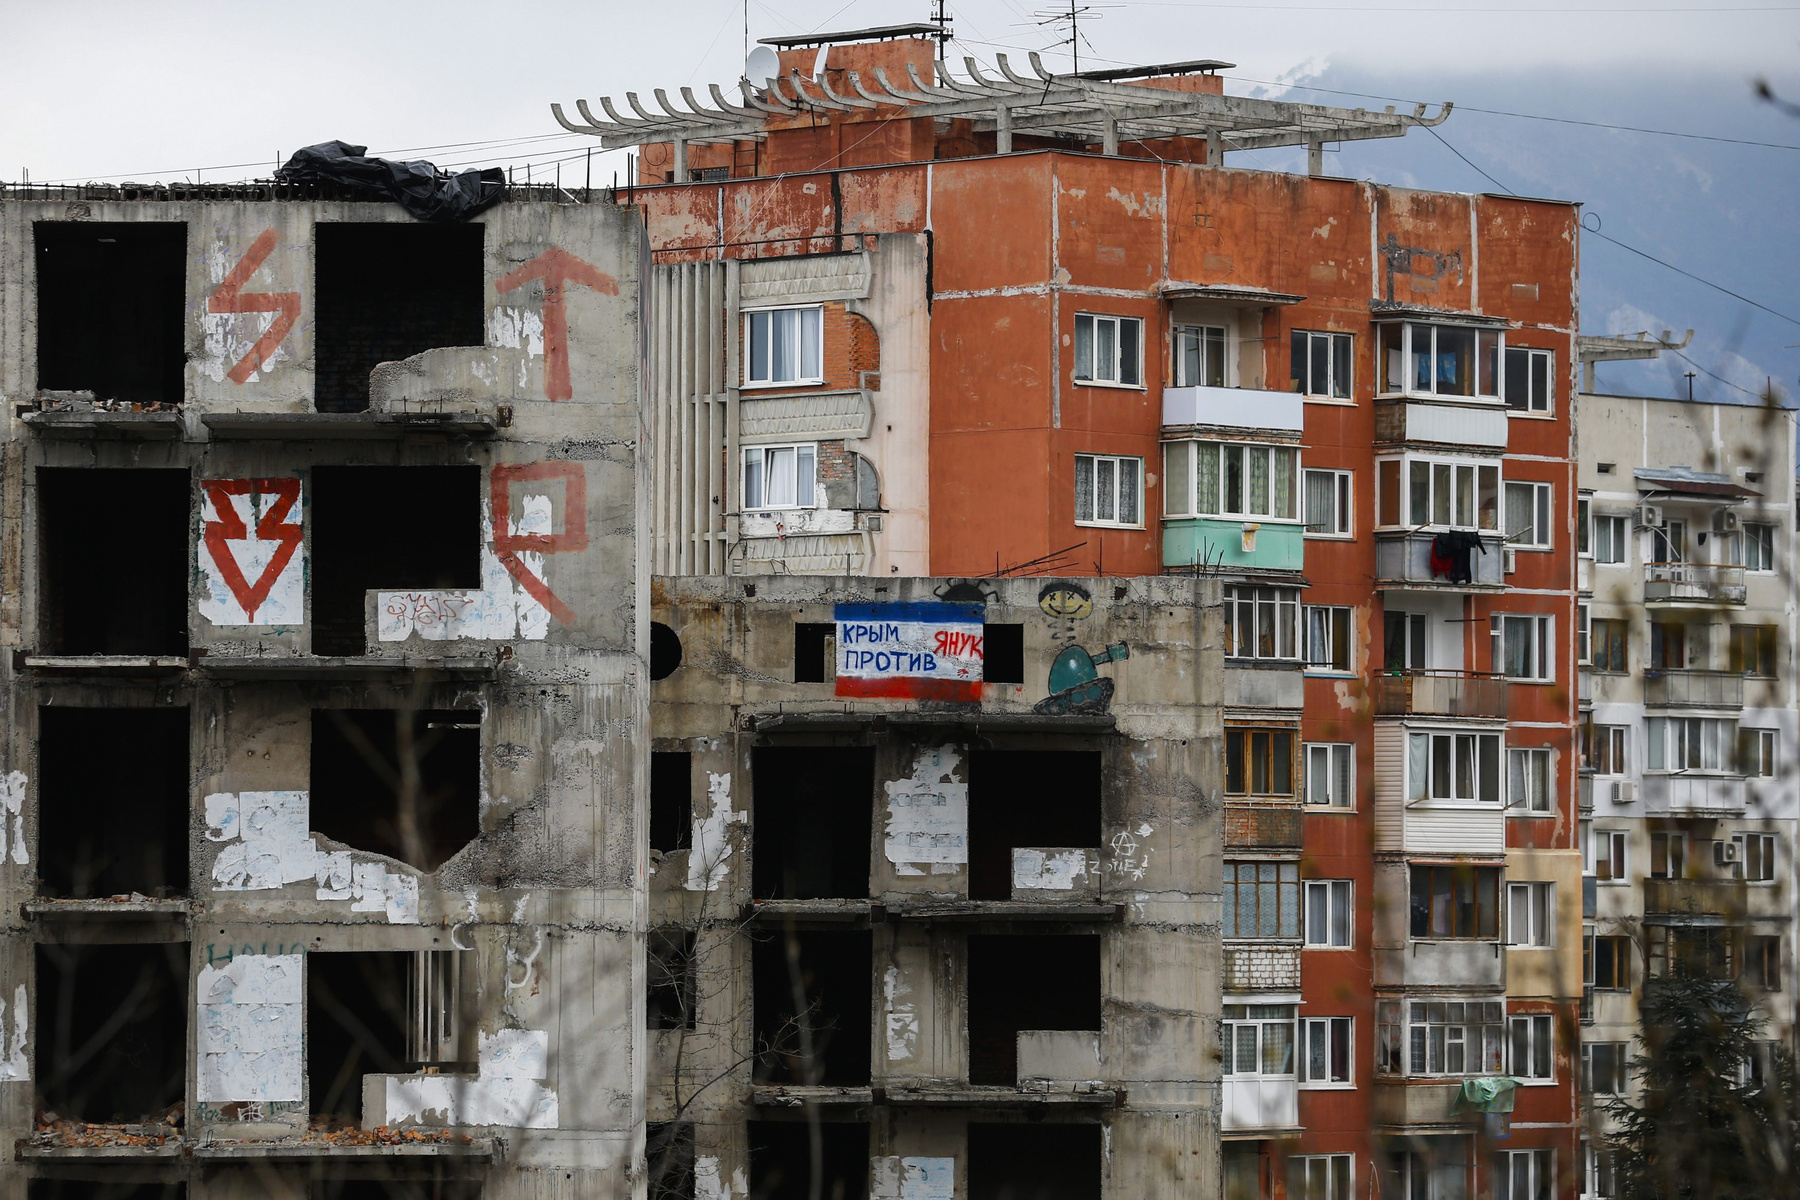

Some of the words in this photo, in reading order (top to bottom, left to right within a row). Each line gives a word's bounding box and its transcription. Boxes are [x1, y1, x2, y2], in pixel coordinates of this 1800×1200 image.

[842, 623, 899, 644] КРЫМ
[933, 630, 984, 660] ЯНУК
[845, 650, 937, 671] ПРОТИВ
